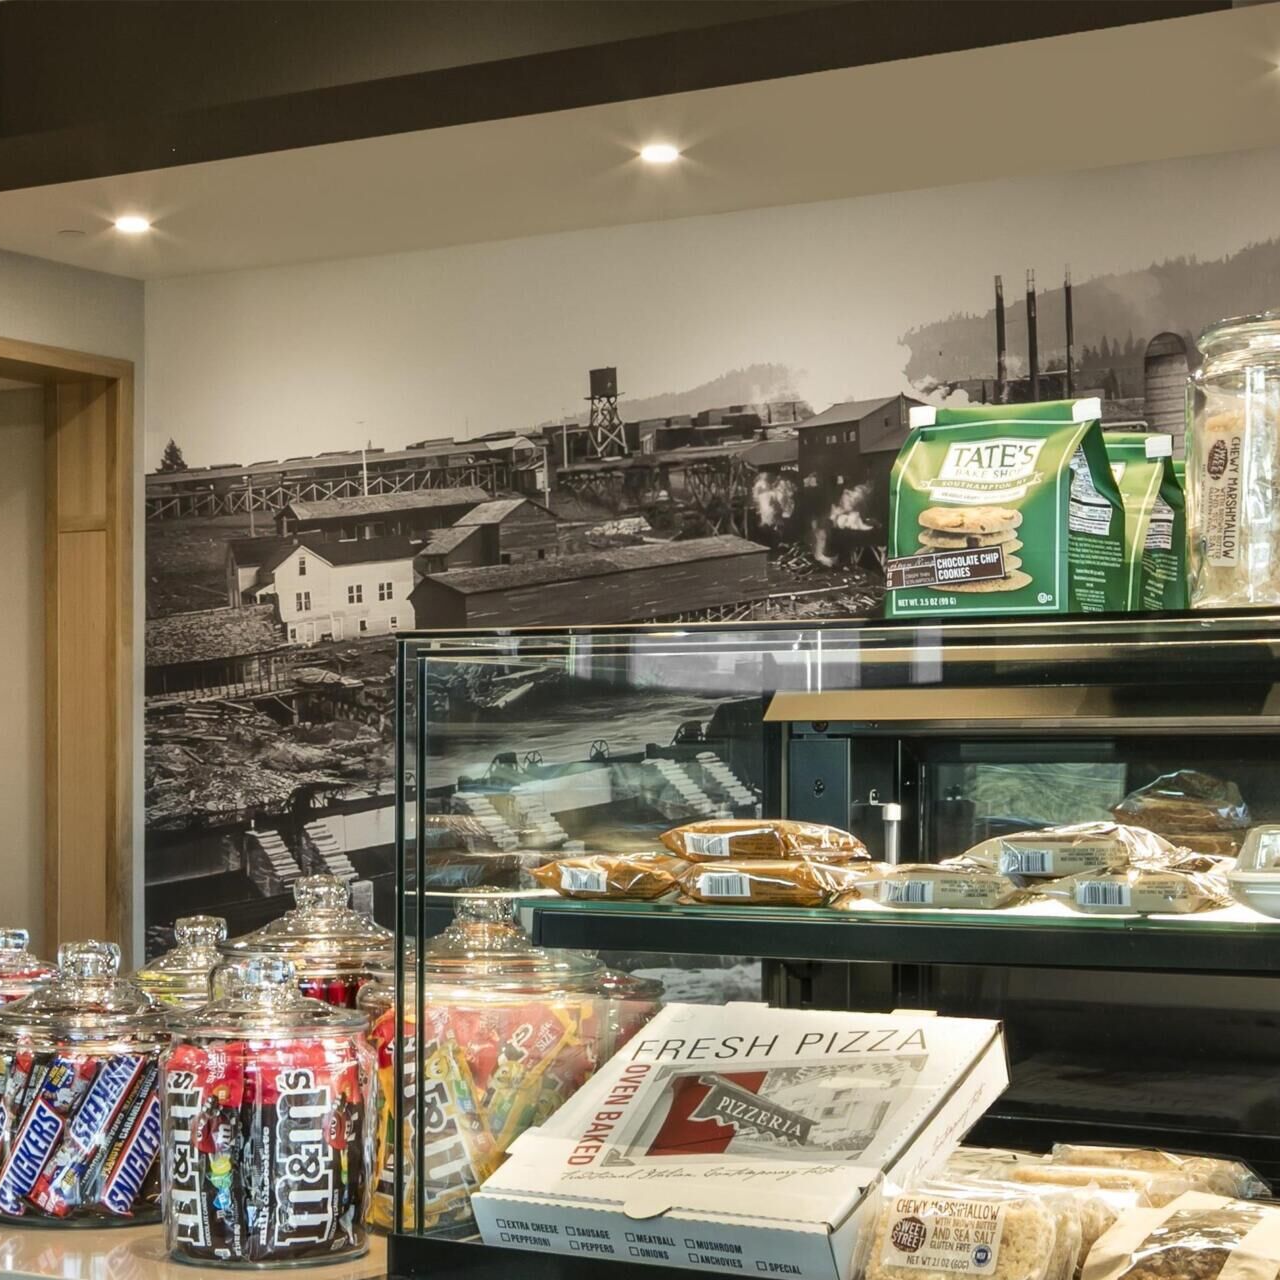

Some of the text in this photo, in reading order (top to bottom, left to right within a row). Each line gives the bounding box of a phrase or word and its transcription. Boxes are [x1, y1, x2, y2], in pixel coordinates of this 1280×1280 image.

[954, 444, 1037, 469] TATE'S
[1222, 437, 1241, 560] CHEWY MARSHMALLOW
[937, 554, 979, 569] CHOCOLATE
[980, 553, 999, 565] CHIP
[938, 567, 971, 580] COOKIES
[631, 1028, 927, 1062] FRESH PIZZA
[567, 1064, 652, 1167] OVEN BAKED
[719, 1095, 802, 1138] PIZZERIA
[896, 1199, 927, 1214] CHEWY
[507, 1219, 559, 1235] EXTRA CHEESE
[577, 1227, 610, 1240] SAUSAGE
[895, 1220, 926, 1237] SWEET
[510, 1233, 551, 1247] PEPPERONI
[636, 1232, 676, 1247] MEATBALL
[892, 1231, 926, 1249] STREET
[931, 1229, 995, 1244] AND SEA SALT
[581, 1241, 615, 1254] PEPPERS
[697, 1239, 743, 1254] MUSHROOM
[930, 1241, 954, 1251] GLUTEN
[640, 1248, 670, 1260] ONIONS
[701, 1254, 743, 1269] ANCHOVIES
[906, 1255, 919, 1265] NET
[921, 1256, 931, 1266] WT
[941, 1258, 950, 1268] OZ
[769, 1262, 802, 1275] SPECIAL
